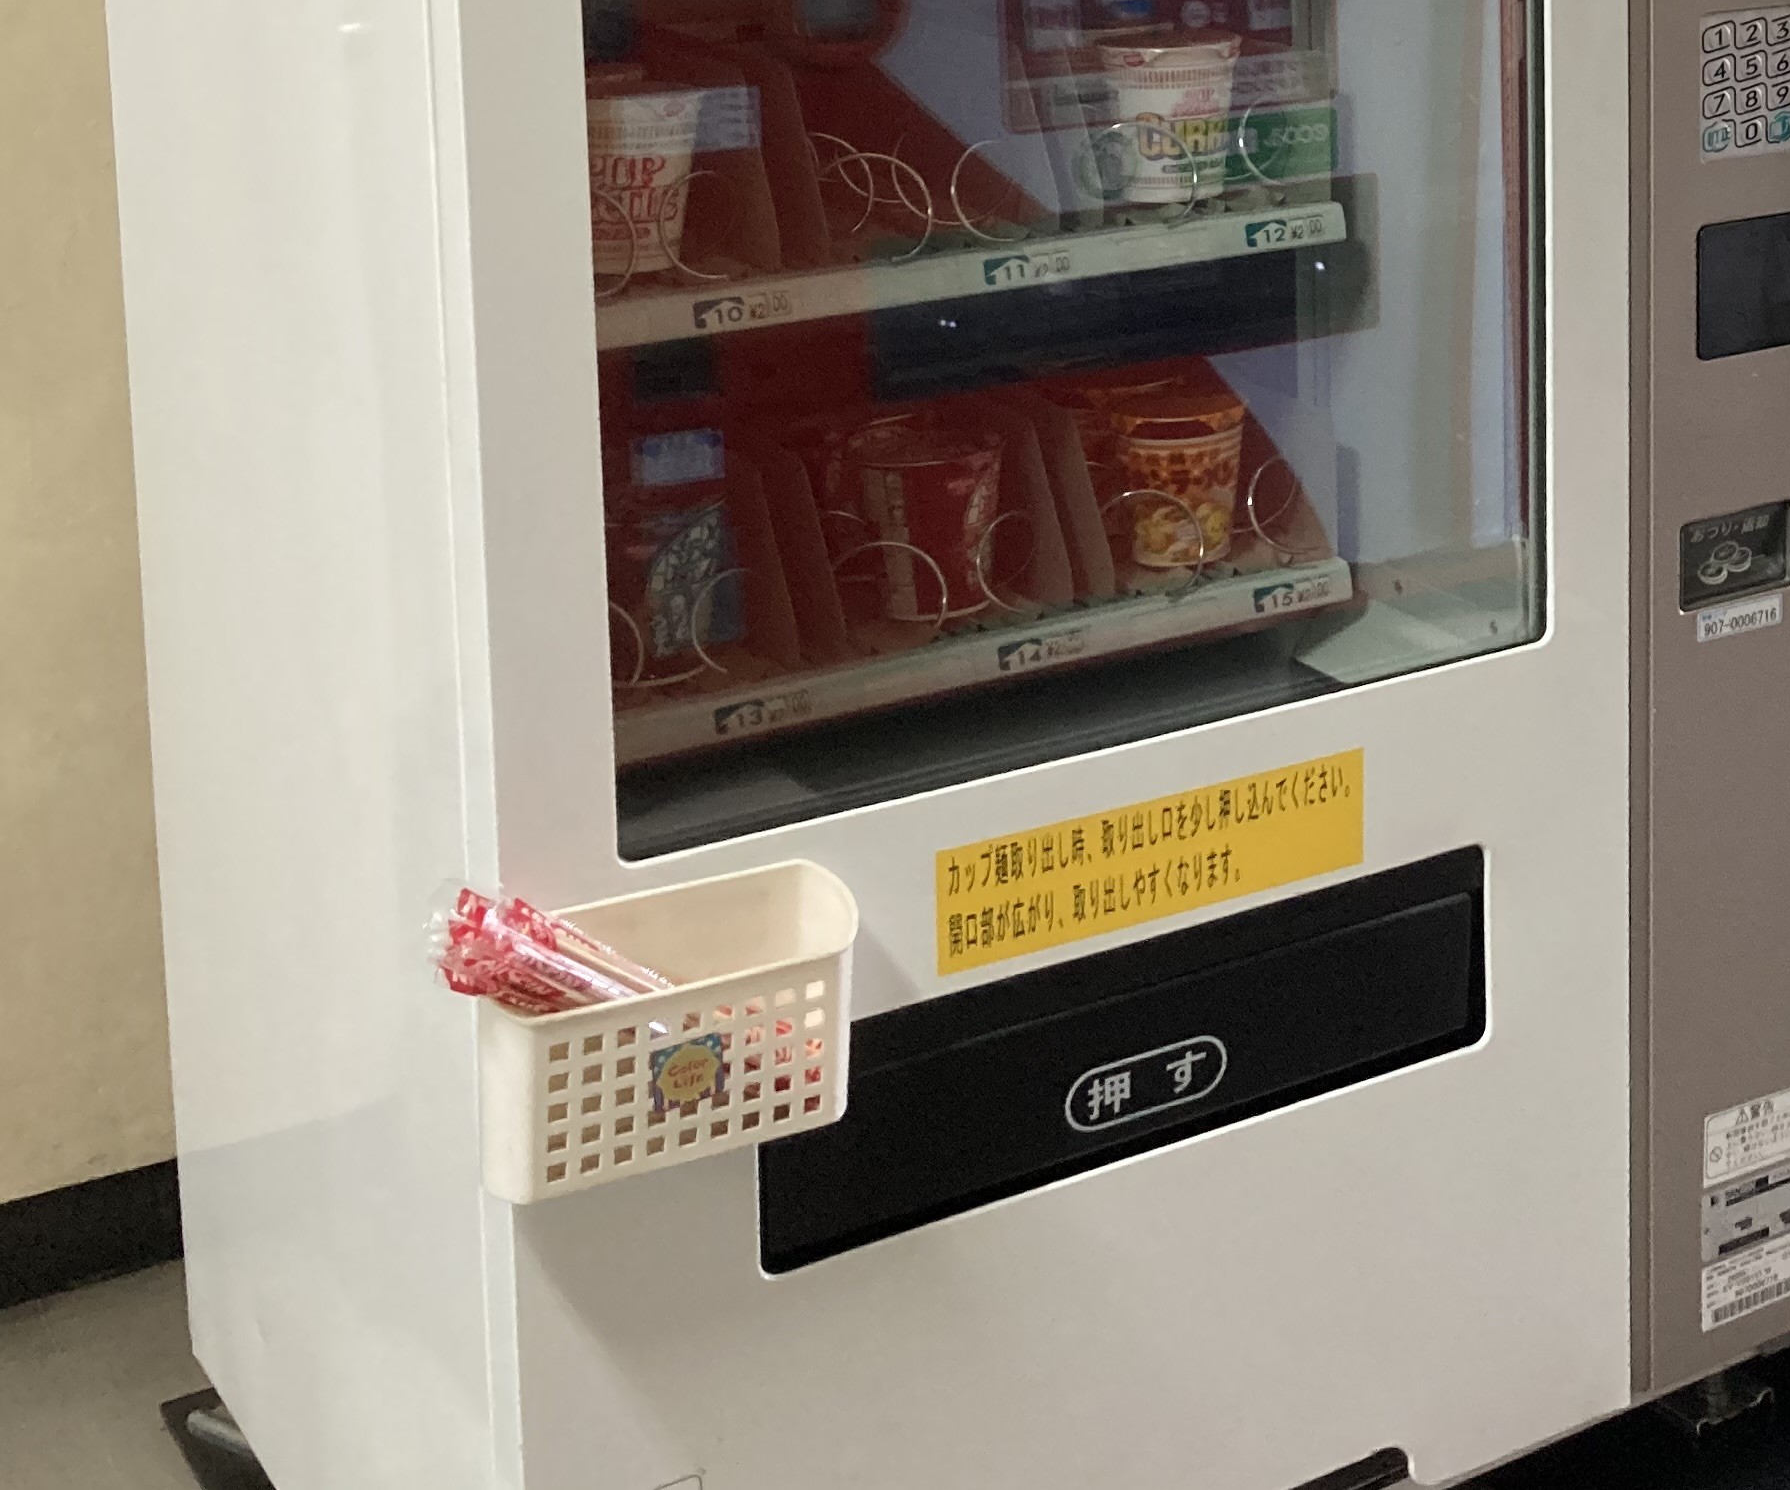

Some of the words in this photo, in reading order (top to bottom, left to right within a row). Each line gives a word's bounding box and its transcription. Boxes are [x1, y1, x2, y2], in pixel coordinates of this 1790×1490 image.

[1715, 28, 1723, 45] 1
[1746, 24, 1758, 42] 2
[1777, 21, 1789, 39] 3
[1714, 61, 1726, 78] 4
[1746, 57, 1758, 75] 5
[1777, 53, 1789, 71] 6
[1714, 94, 1725, 112] 7
[1745, 90, 1758, 108] 8
[1776, 86, 1789, 104] 9
[1745, 123, 1758, 140] 0
[1263, 229, 1285, 243] 12
[1004, 263, 1025, 279] 11
[715, 307, 742, 325] 10
[948, 762, 1351, 898] カップ麺取り出し時、取り出し口を少し押し込んでください。
[948, 846, 1242, 958] 開口部が広がり、取り出しやすくなります。
[1087, 1049, 1207, 1121] 押す
